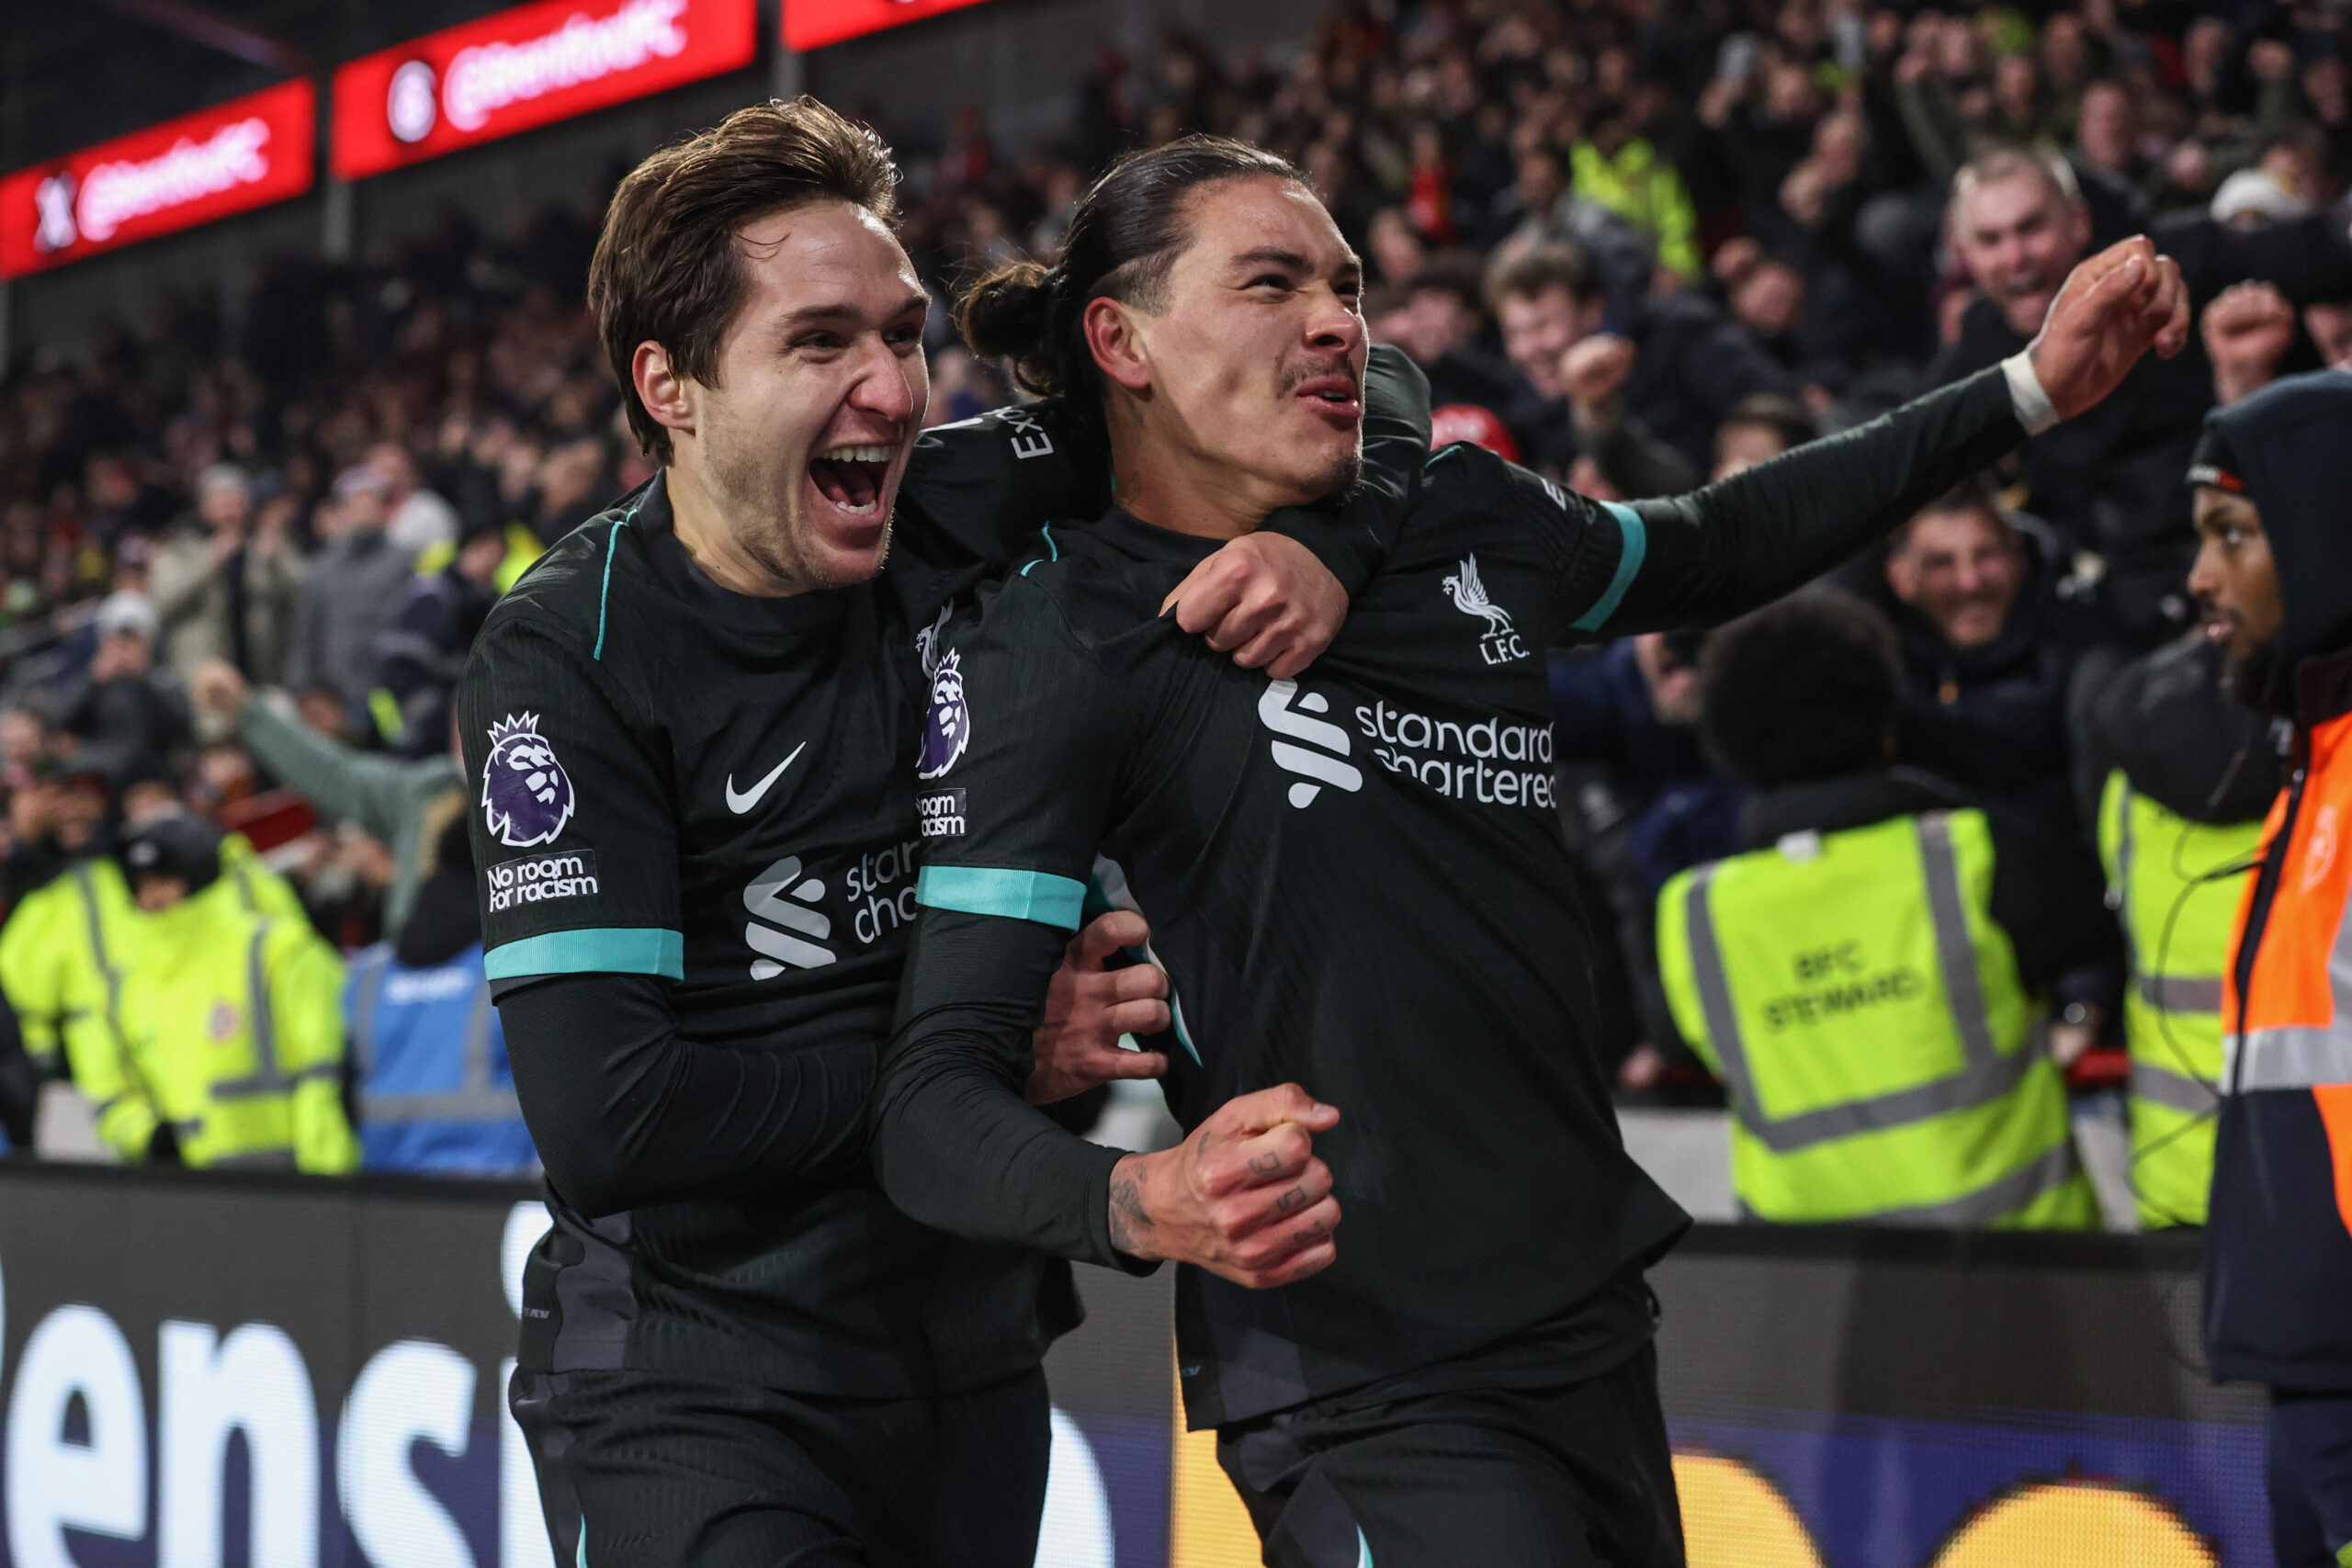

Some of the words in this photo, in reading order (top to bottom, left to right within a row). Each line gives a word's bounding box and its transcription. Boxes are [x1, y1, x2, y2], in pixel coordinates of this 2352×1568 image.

[1355, 700, 1555, 763] standard
[922, 816, 966, 837] acism
[487, 866, 514, 893] No
[516, 856, 584, 884] room
[517, 875, 599, 904] racism
[1794, 940, 1865, 980] BFC
[1763, 967, 1926, 1034] STEWARD
